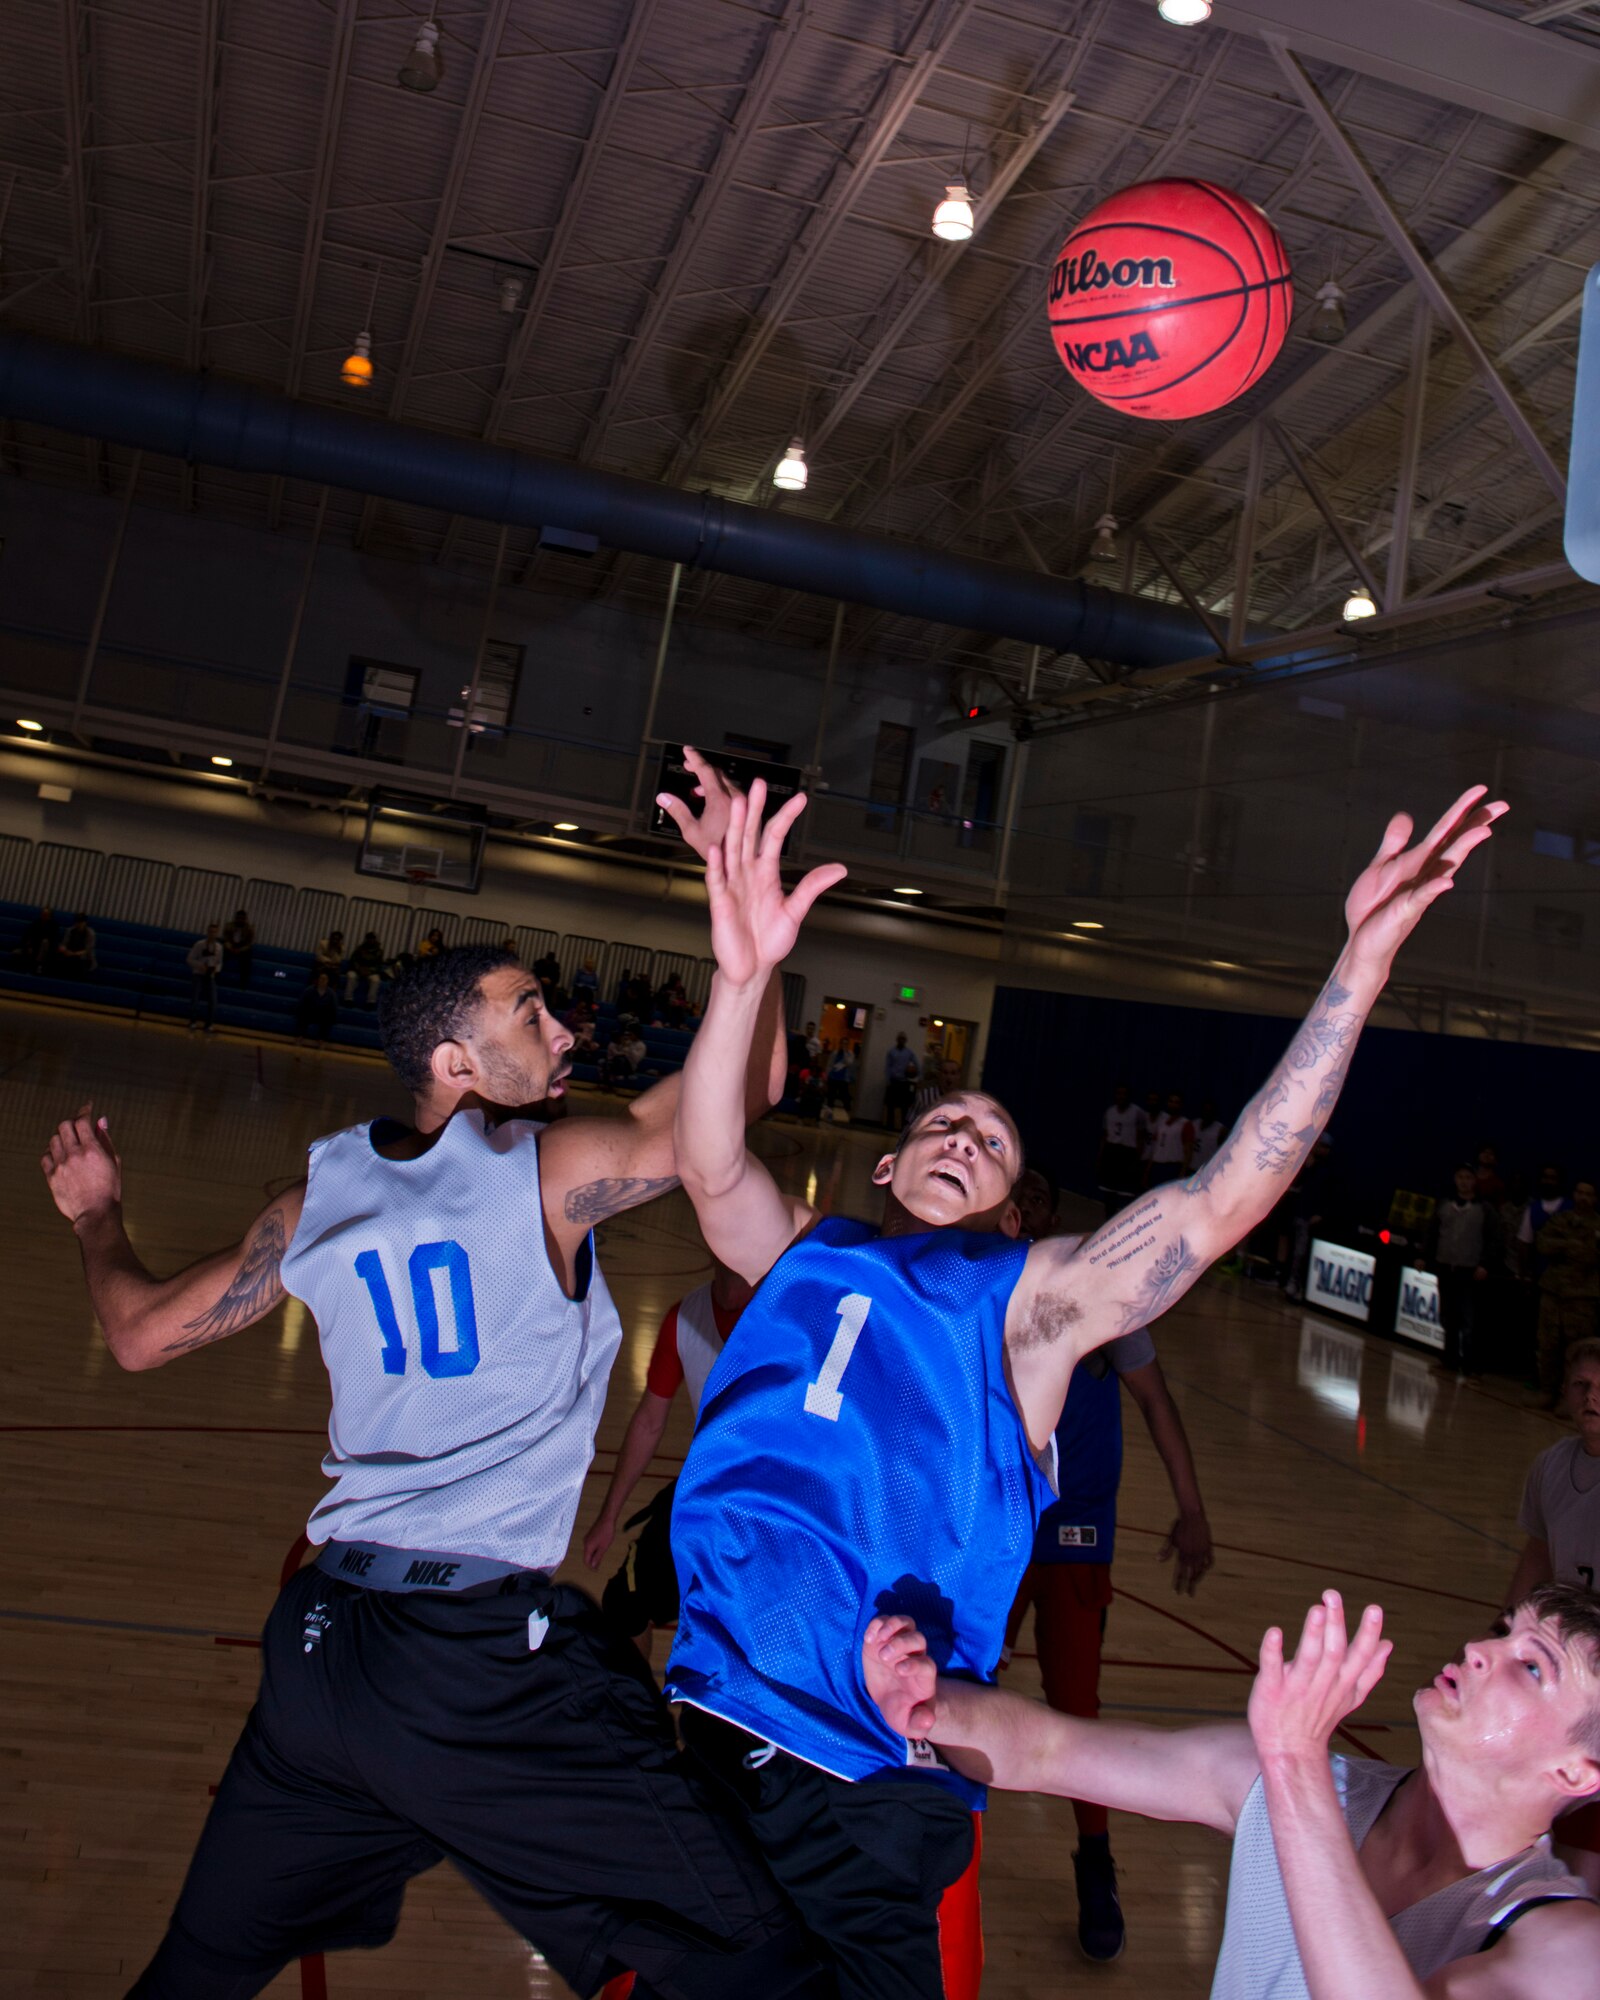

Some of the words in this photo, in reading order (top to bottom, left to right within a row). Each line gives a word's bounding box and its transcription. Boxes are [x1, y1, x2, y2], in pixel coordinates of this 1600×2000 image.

[1064, 330, 1161, 372] NCAA
[355, 1240, 480, 1379] 10
[803, 1292, 873, 1422] 1
[338, 1547, 377, 1577] NIKE
[402, 1559, 462, 1587] NIKE
